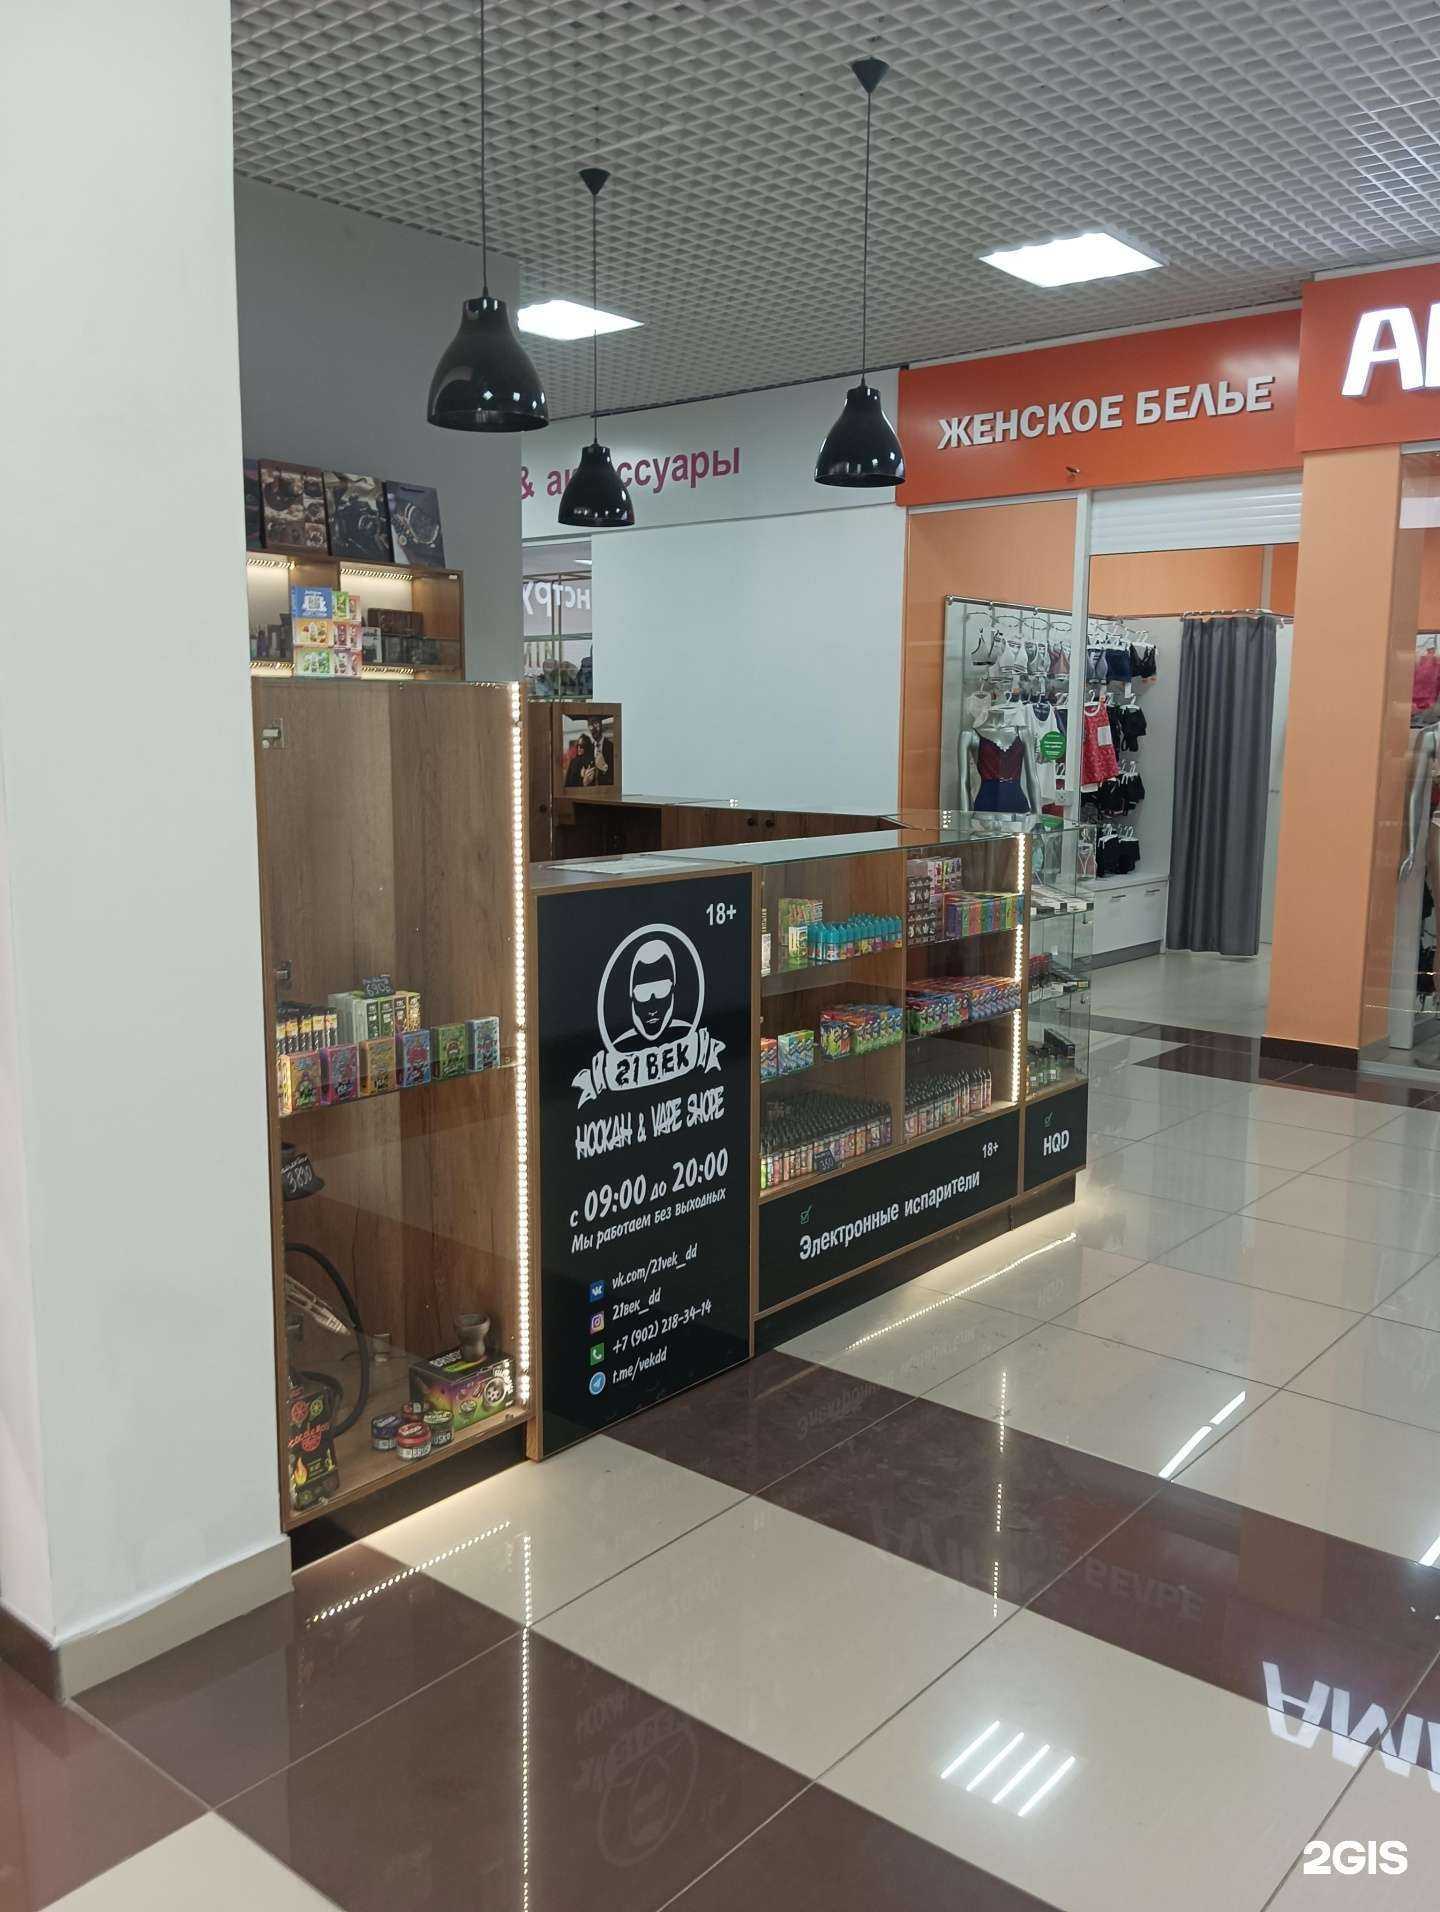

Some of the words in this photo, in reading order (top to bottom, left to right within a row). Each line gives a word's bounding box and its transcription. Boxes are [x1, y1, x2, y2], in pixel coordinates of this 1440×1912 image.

[1340, 302, 1440, 396] А
[937, 394, 1123, 450] ЖЕНСКОЕ
[1135, 375, 1275, 426] БЕЛЬЕ
[546, 447, 740, 497] ассуары
[706, 902, 737, 926] 18+
[575, 1112, 633, 1160] HOOKAH
[636, 1113, 647, 1143] &
[650, 1097, 682, 1138] VAPE
[686, 1085, 725, 1127] SHOPE
[1043, 1128, 1070, 1156] HQD
[982, 1140, 999, 1159] 18+
[569, 1210, 579, 1228] с
[584, 1174, 647, 1223] 09:00
[650, 1181, 667, 1201] до
[672, 1148, 729, 1193] 20:00
[571, 1233, 594, 1254] Мы
[596, 1213, 651, 1250] работаем
[799, 1202, 900, 1261] Электронные
[904, 1170, 980, 1218] испарители
[611, 1243, 698, 1290] vk.com/21vek_dd
[612, 1335, 629, 1354] +7
[631, 1321, 659, 1347] (902)
[661, 1299, 712, 1335] 218-34-14
[612, 1346, 667, 1384] t.me/vekdd
